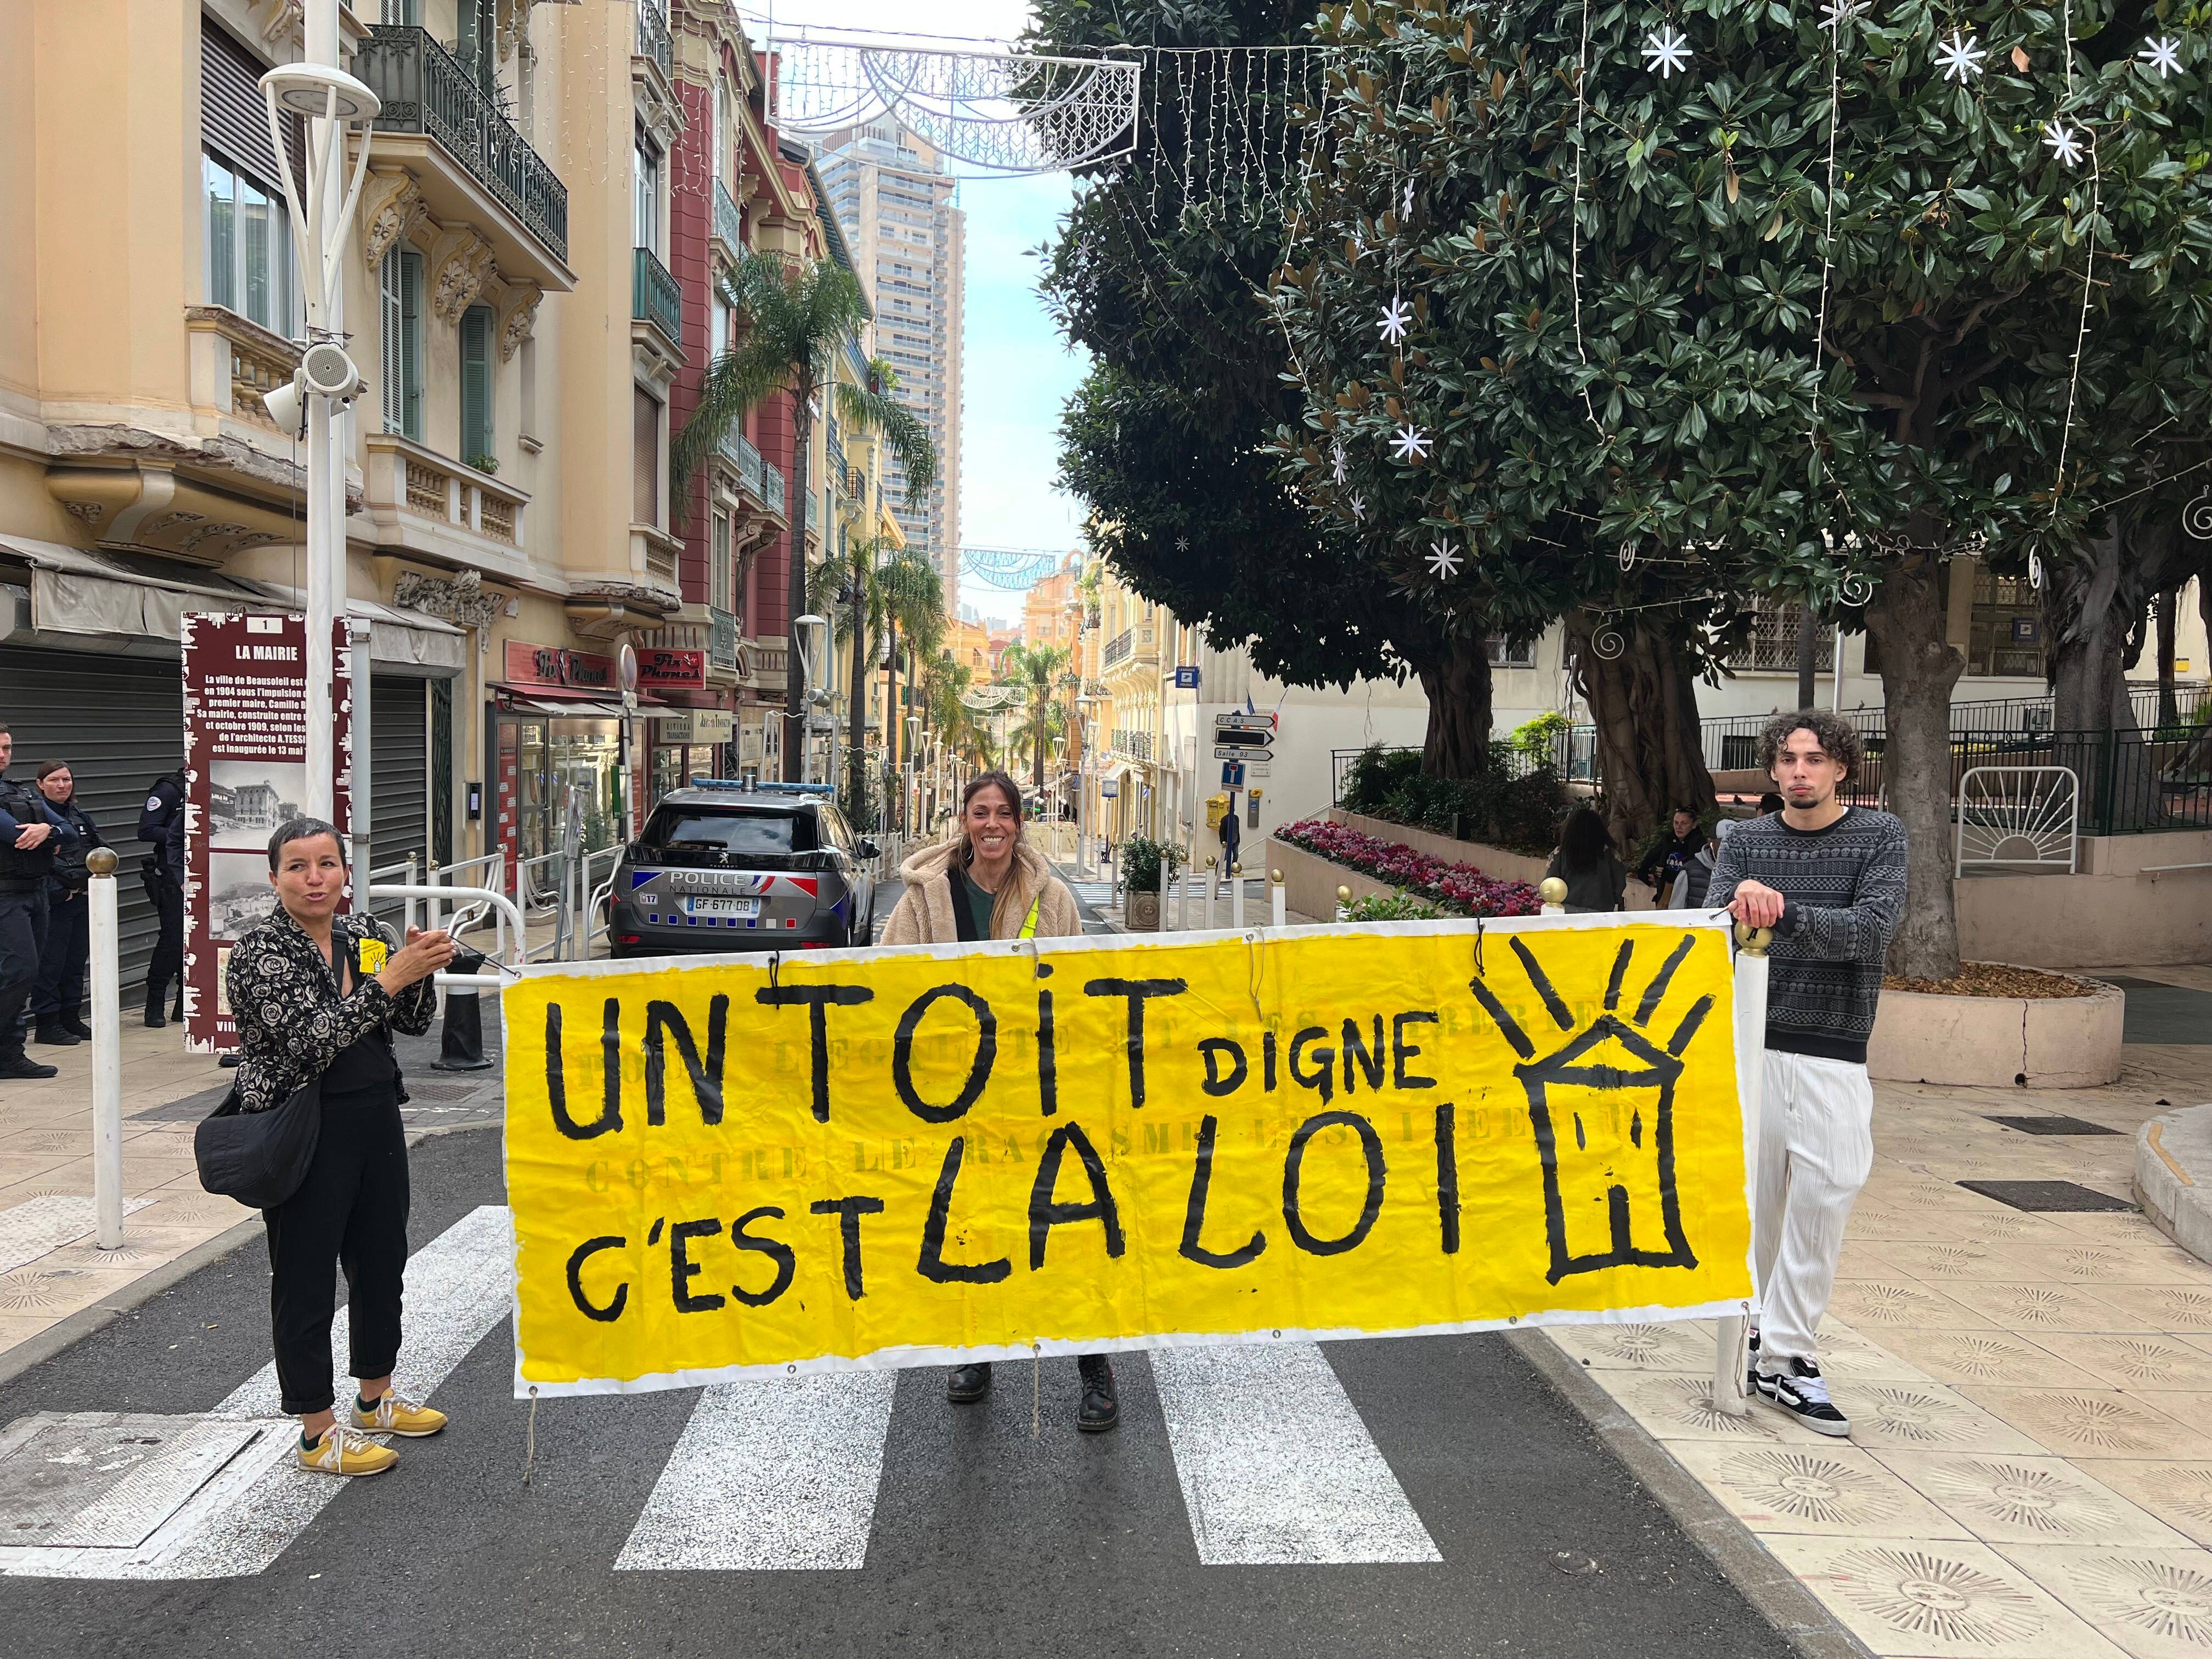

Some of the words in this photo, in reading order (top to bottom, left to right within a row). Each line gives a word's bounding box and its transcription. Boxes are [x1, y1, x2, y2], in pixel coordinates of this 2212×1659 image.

[263, 619, 267, 630] 1
[235, 645, 251, 659] LA
[253, 646, 298, 661] MAIRIE
[205, 675, 214, 684] La
[216, 675, 233, 684] ville
[235, 676, 245, 685] de
[246, 676, 289, 686] Beausoleil
[291, 678, 303, 686] est
[216, 687, 235, 696] 1904
[257, 687, 302, 698] l'impulsion
[208, 698, 241, 707] premier
[242, 699, 267, 709] maire,
[269, 699, 300, 709] Camille
[196, 709, 207, 718] Sa
[208, 710, 236, 719] mairie,
[238, 711, 279, 720] construite
[280, 713, 302, 721] entre
[215, 721, 246, 731] octobre
[247, 722, 269, 732] 1909,
[270, 723, 292, 732] selon
[294, 723, 306, 732] les
[219, 733, 229, 741] de
[231, 732, 276, 742] l'architecte
[212, 744, 225, 753] est
[227, 744, 267, 754] inaugurée
[268, 745, 276, 754] le
[278, 746, 286, 755] 13
[288, 746, 303, 755] mai
[670, 872, 747, 886] POLICE
[669, 885, 746, 895] NATIONALE
[546, 994, 730, 1141] UN
[1197, 1011, 1440, 1106] DIGNE
[566, 1195, 884, 1322] C'EST
[917, 1121, 1125, 1284] LA
[1178, 1102, 1462, 1269] LOI
